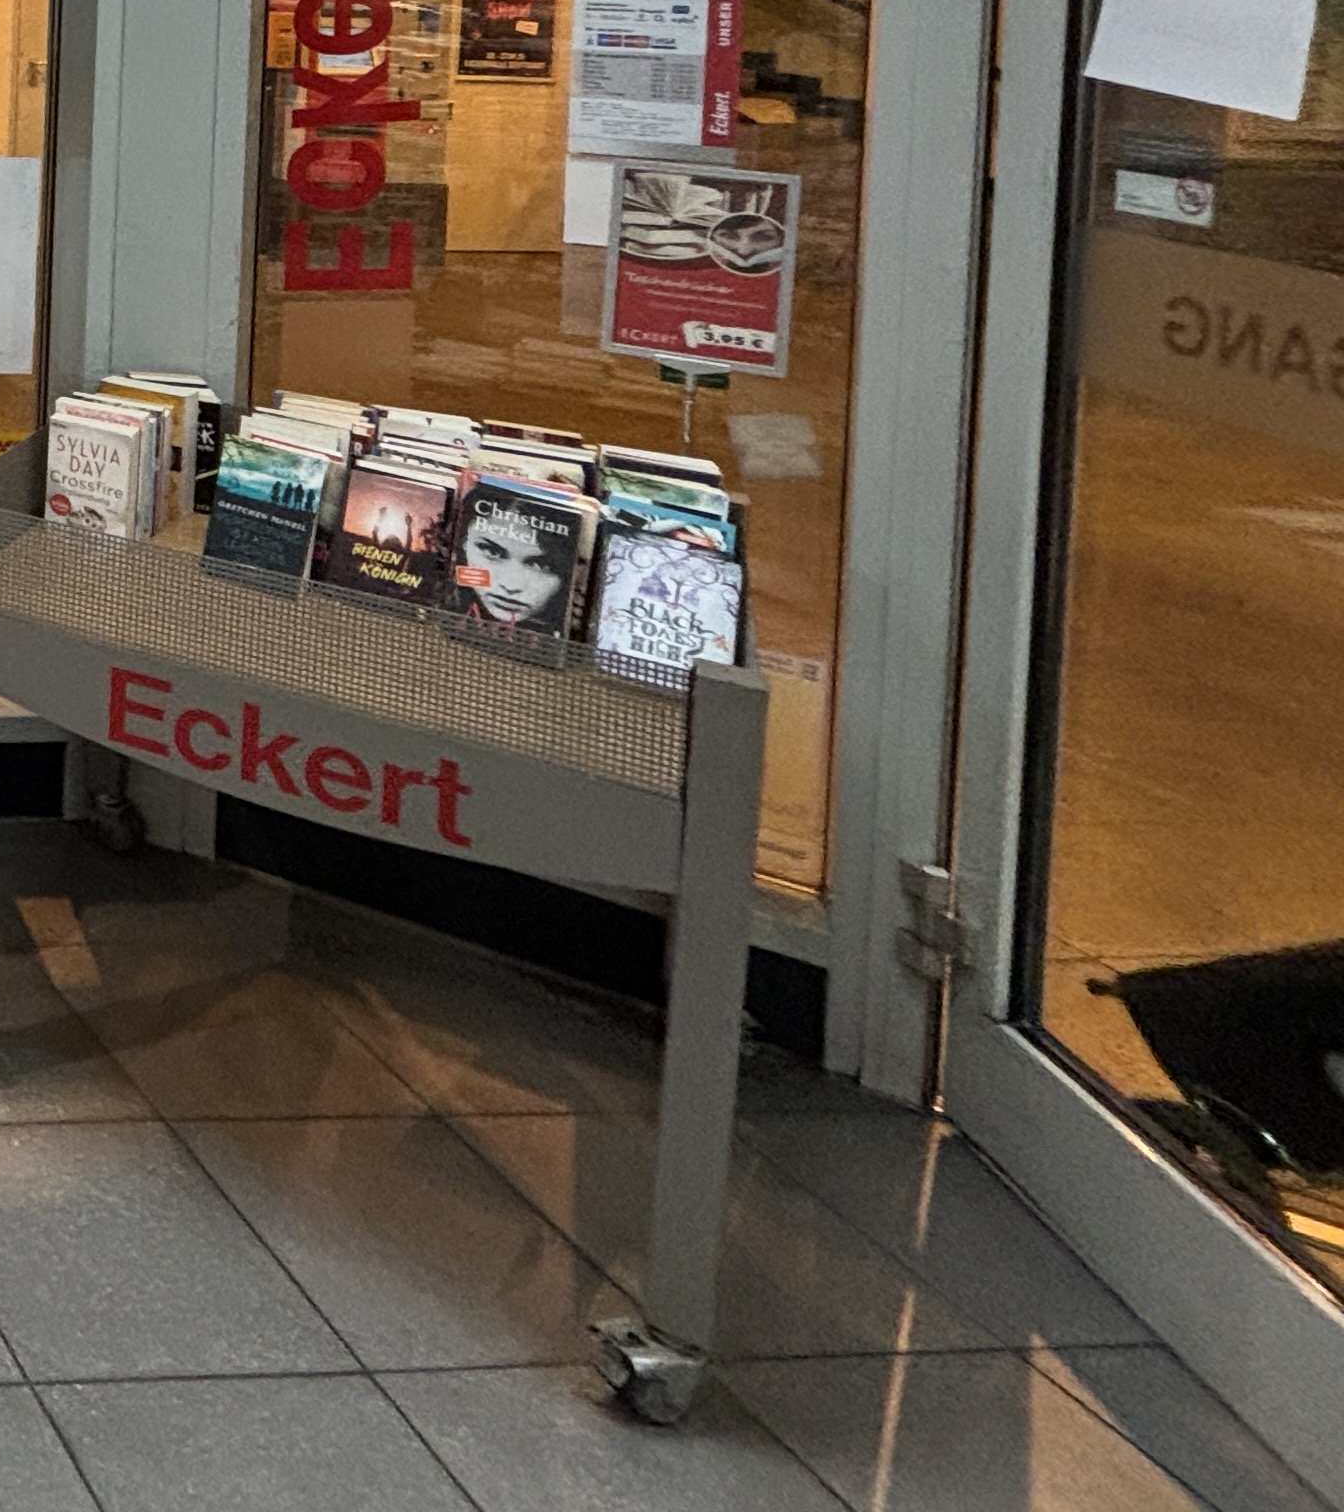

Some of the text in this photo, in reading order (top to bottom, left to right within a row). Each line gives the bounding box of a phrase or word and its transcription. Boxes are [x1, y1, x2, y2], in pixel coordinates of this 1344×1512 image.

[718, 2, 733, 46] UNSER
[56, 434, 120, 465] SYLVIA
[70, 455, 105, 478] DAY
[50, 470, 124, 499] Crossfire
[217, 500, 268, 520] GRETCHEN
[474, 499, 570, 536] Christian
[474, 516, 538, 546] Berkel
[352, 542, 404, 566] BIENEN
[360, 562, 423, 588] KÖNIGIN
[628, 597, 705, 635] BLACK
[108, 666, 472, 849] Eckert
